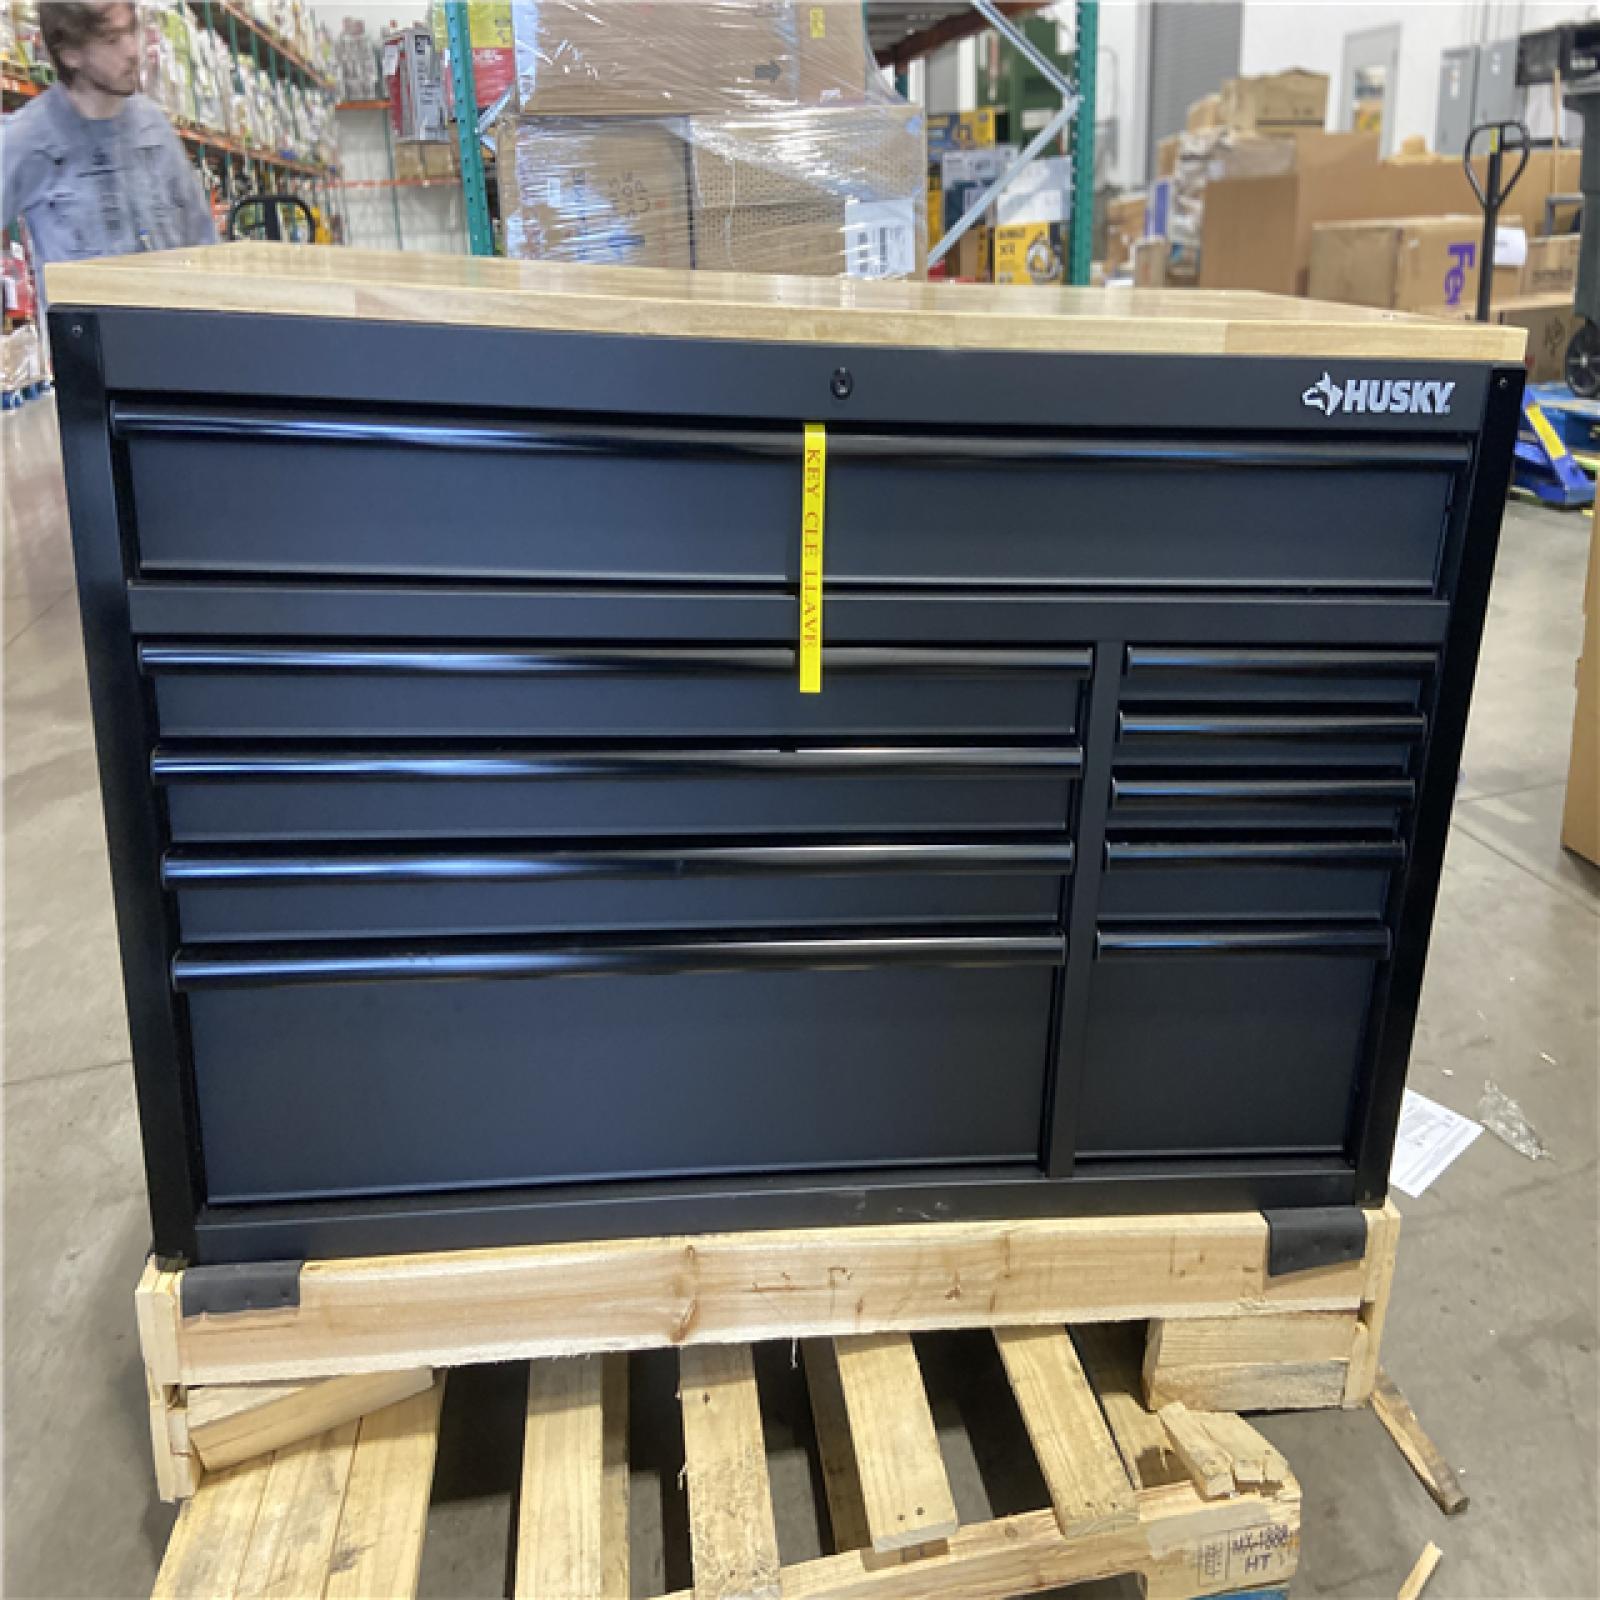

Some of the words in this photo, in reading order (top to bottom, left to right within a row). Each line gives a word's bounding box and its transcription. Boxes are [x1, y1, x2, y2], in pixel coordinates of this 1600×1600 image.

[1444, 242, 1476, 305] Fe
[1343, 379, 1456, 415] HUSKY
[806, 449, 821, 498] KEY
[1244, 1553, 1271, 1574] HT
